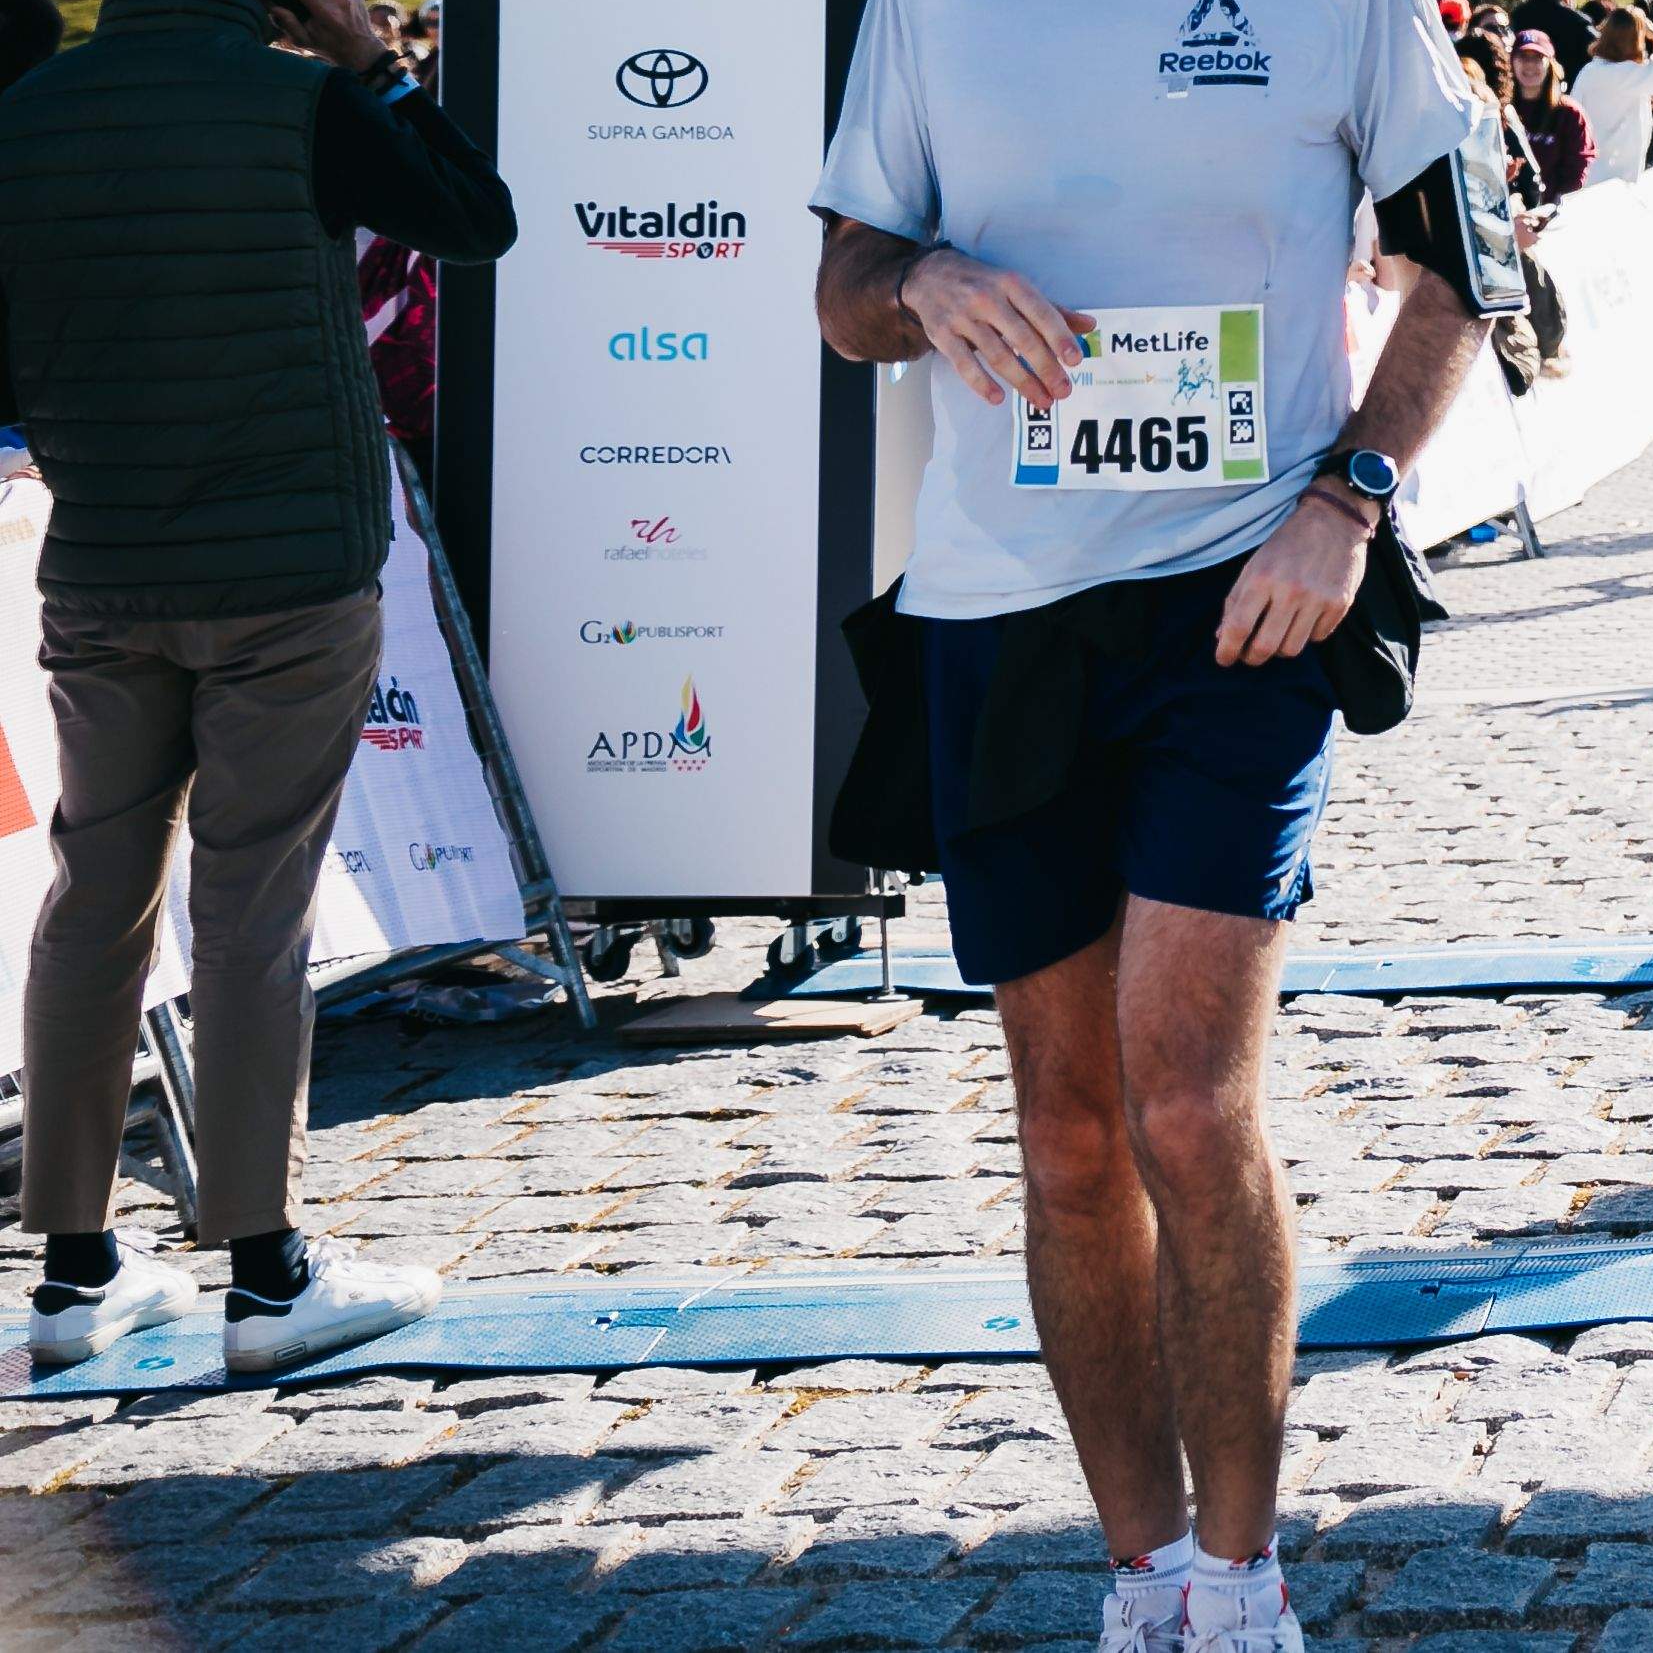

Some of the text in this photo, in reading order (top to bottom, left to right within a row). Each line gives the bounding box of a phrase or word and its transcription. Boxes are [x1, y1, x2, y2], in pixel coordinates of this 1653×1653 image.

[1158, 50, 1272, 73] Reebok
[587, 124, 735, 140] SUPRA GAMBOA
[574, 200, 746, 238] Vitaldin
[666, 242, 745, 260] SPORT
[609, 326, 709, 362] alsa
[1111, 331, 1210, 354] MetLife
[1070, 415, 1210, 475] 4465
[637, 625, 725, 638] PUBLISPORT
